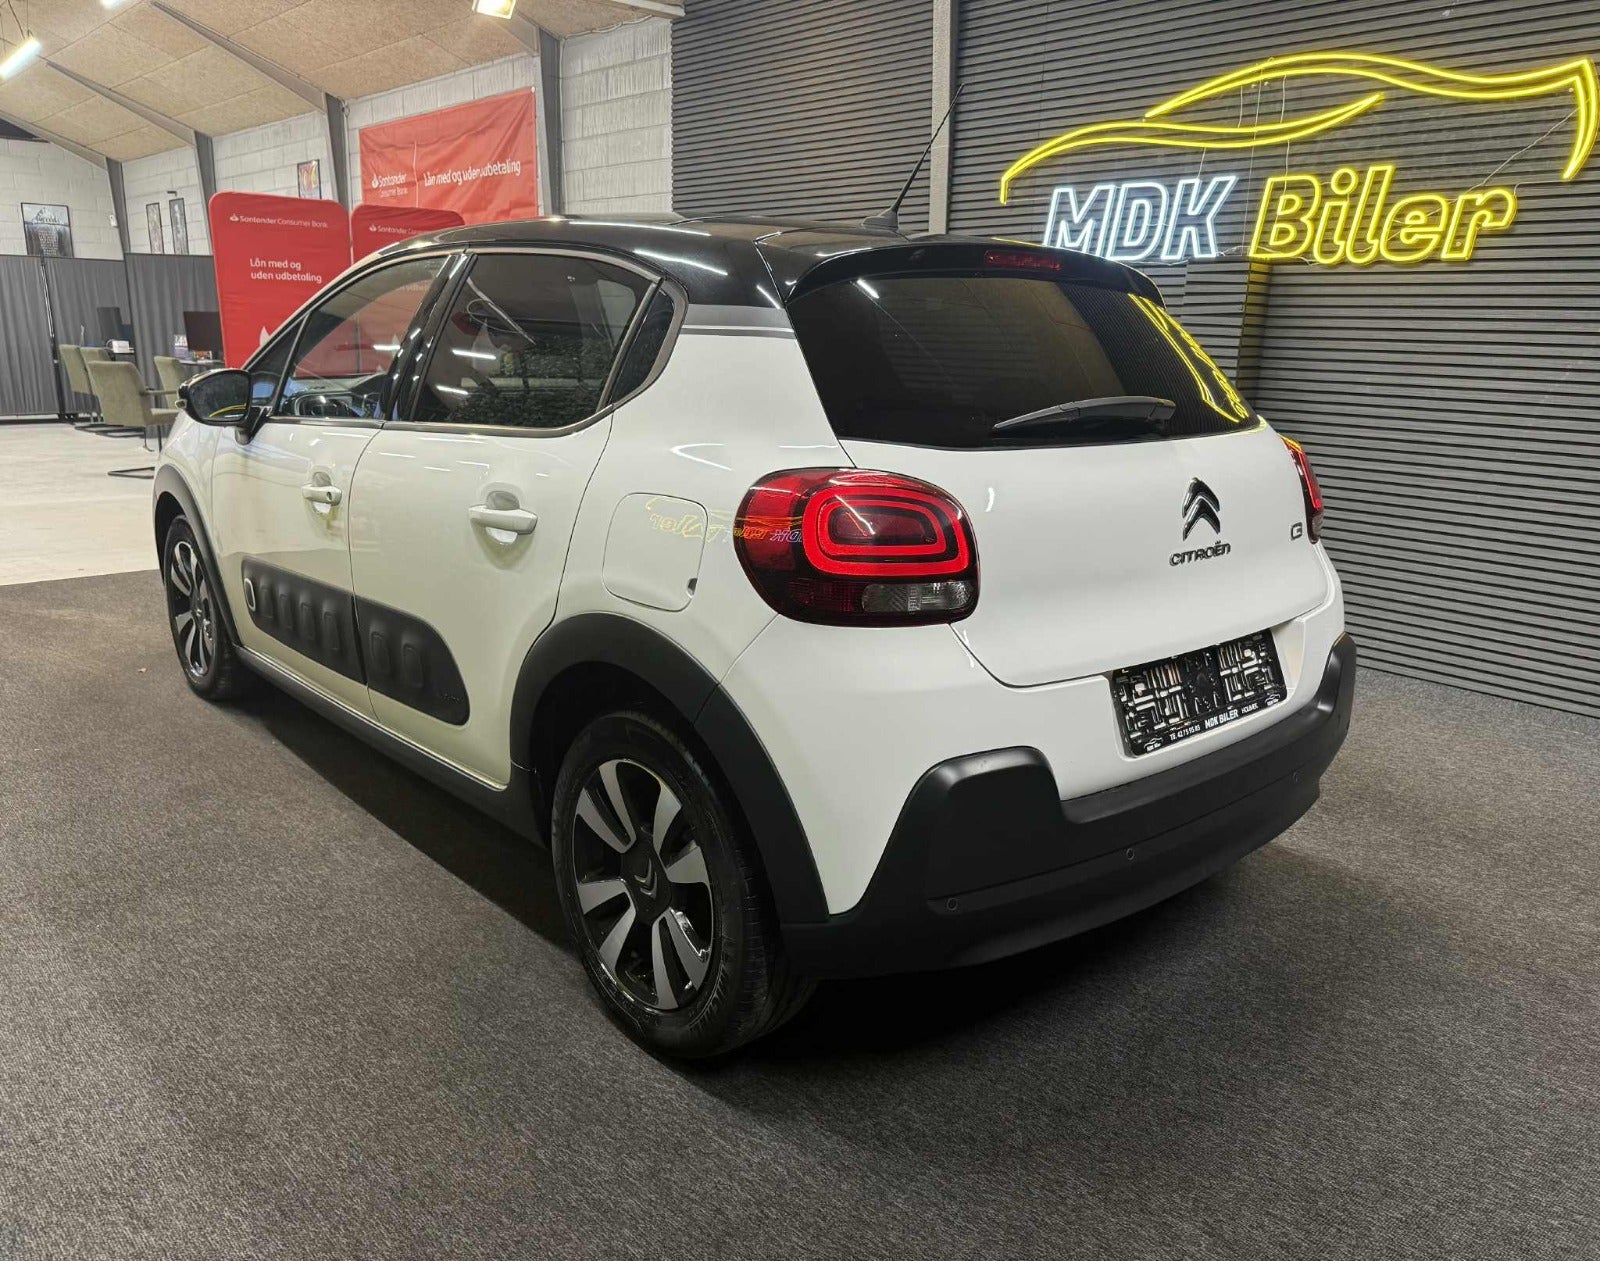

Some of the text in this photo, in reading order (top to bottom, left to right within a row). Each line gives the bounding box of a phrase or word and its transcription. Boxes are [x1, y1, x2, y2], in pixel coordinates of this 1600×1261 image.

[379, 173, 407, 188] Santander
[424, 171, 436, 187] Lån
[436, 169, 451, 185] med
[452, 170, 463, 186] og
[1042, 164, 1518, 265] MDK Biler
[240, 215, 329, 229] Santander Consumer Bank
[377, 225, 408, 235] Santander
[249, 257, 302, 271] Lån med og
[250, 271, 323, 284] uden udbetaling
[1204, 715, 1220, 729] MDK
[1218, 709, 1239, 726] BILER
